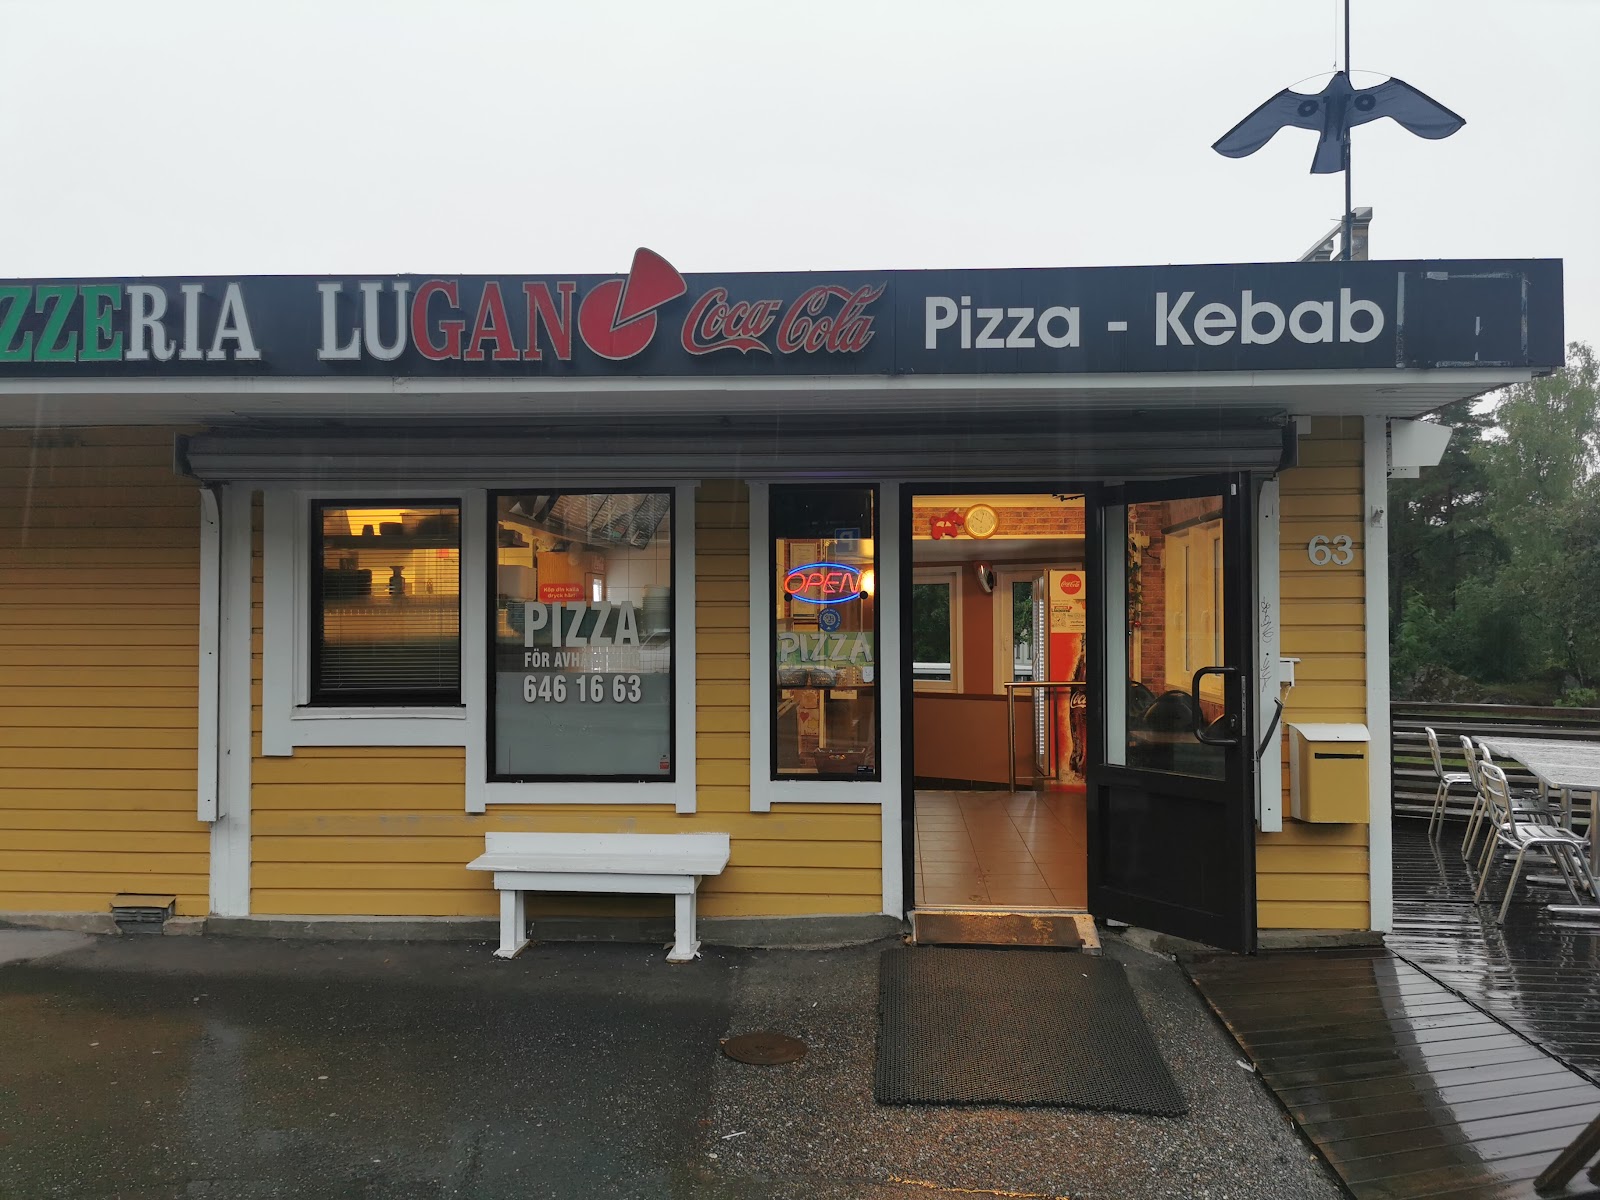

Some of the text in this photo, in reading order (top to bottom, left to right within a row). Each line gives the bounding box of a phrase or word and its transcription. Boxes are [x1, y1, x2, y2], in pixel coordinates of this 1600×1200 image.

[925, 287, 1385, 350] Pizza - Kebab
[1307, 534, 1354, 566] 63
[783, 572, 863, 595] OPEN
[524, 600, 640, 648] PIZZA
[524, 648, 550, 668] FÖR
[778, 632, 873, 663] PIZZA
[523, 674, 642, 703] 646 16 63
